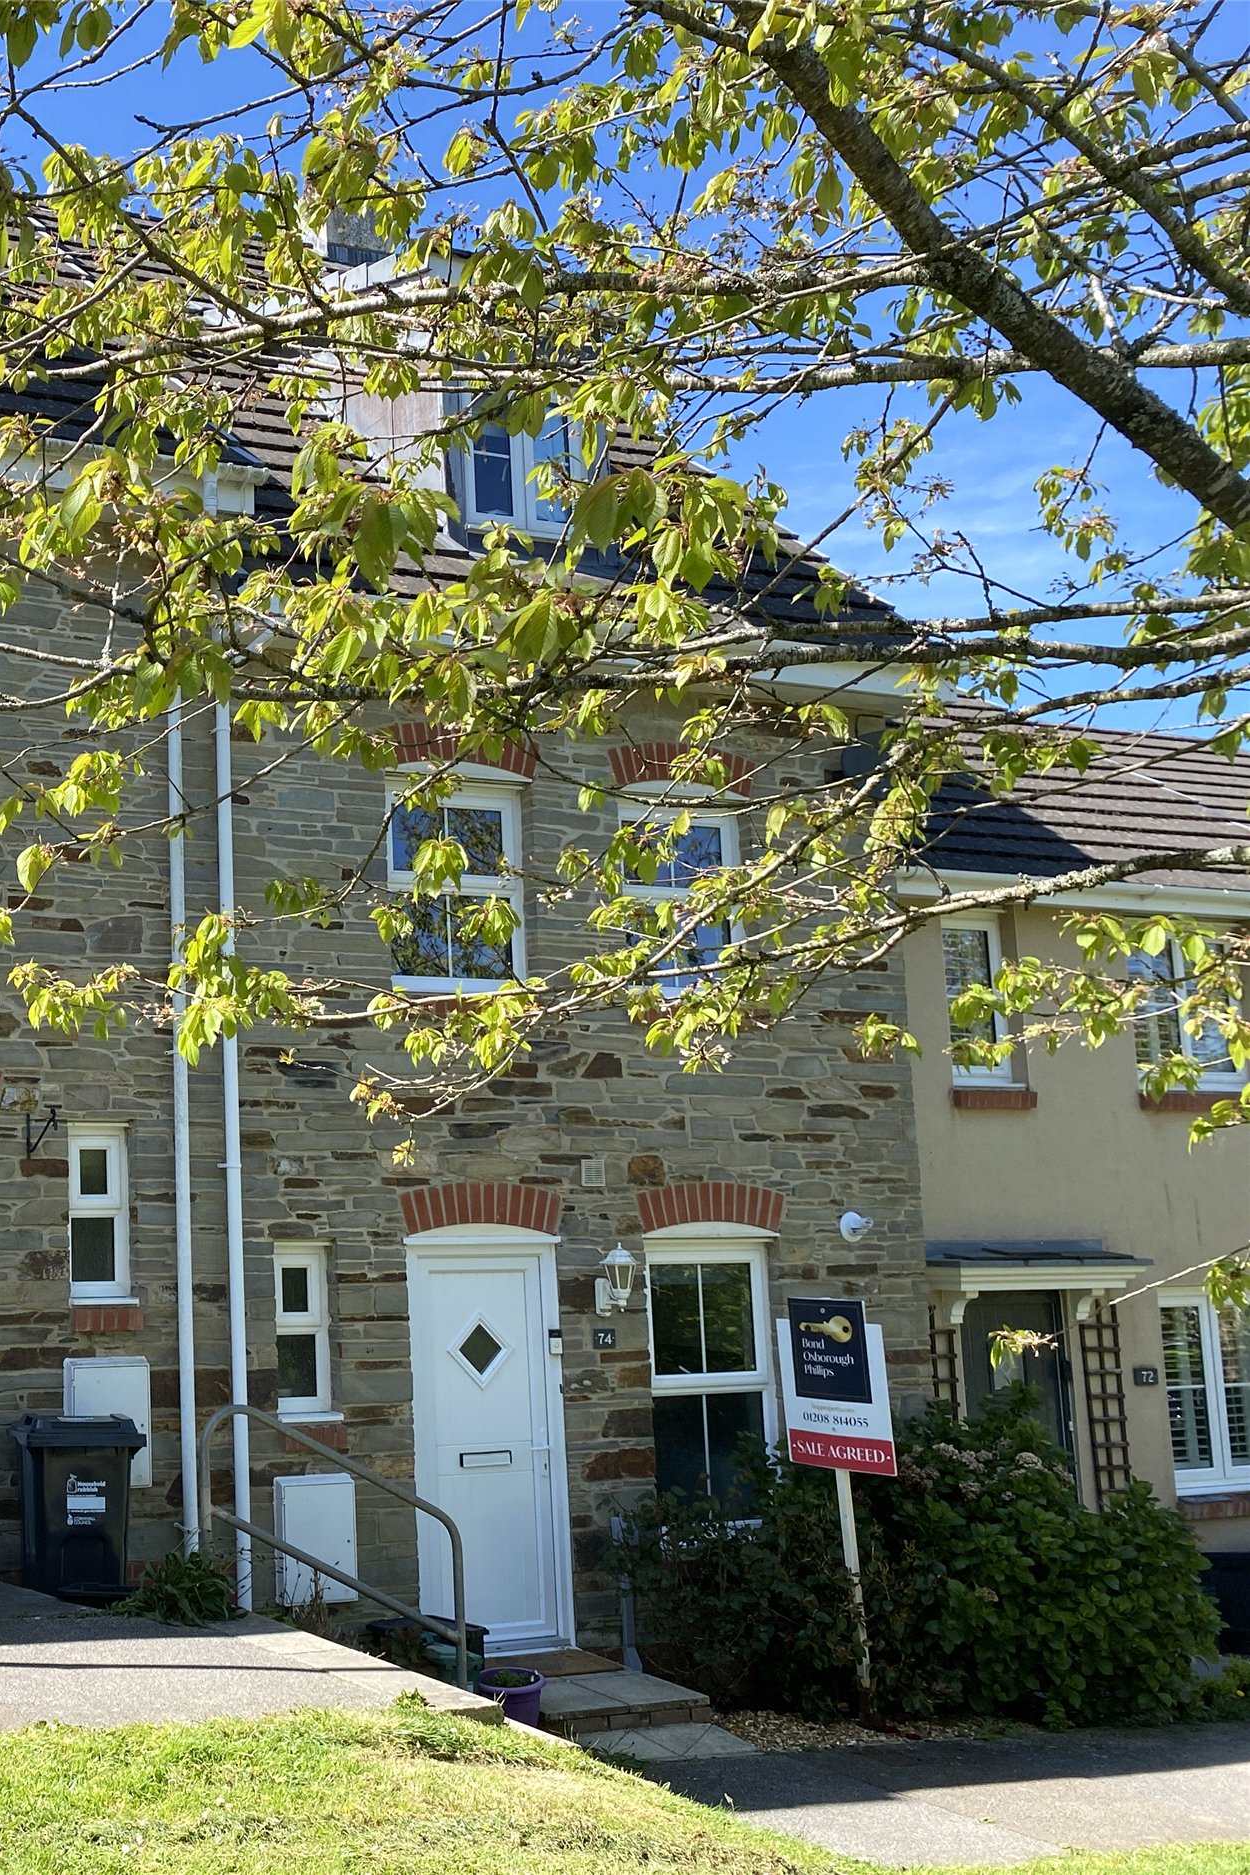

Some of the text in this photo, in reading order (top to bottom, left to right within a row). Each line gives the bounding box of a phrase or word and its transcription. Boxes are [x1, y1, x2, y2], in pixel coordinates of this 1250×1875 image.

[597, 1332, 613, 1345] 74
[801, 1337, 825, 1350] Bond
[803, 1350, 854, 1367] Oxborough
[804, 1363, 835, 1379] Phillips
[1141, 1370, 1155, 1383] 72
[802, 1411, 869, 1428] 01208 814055
[796, 1440, 886, 1464] SALE AGREED
